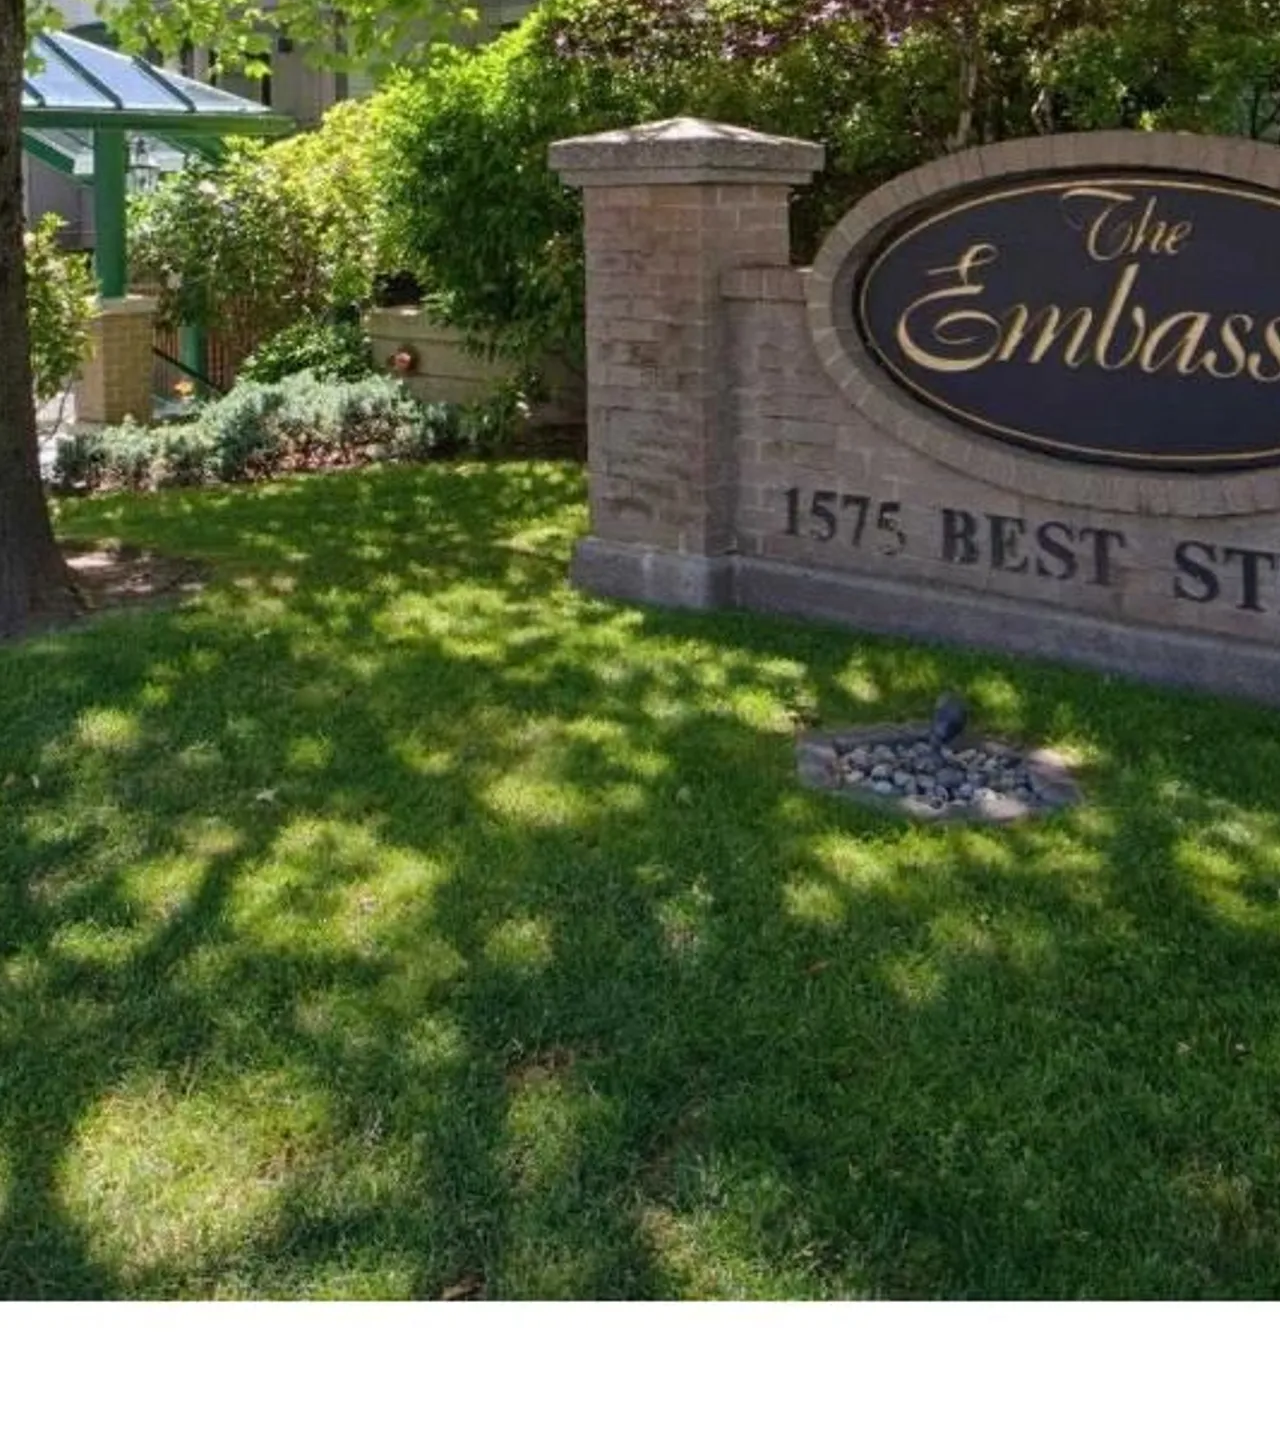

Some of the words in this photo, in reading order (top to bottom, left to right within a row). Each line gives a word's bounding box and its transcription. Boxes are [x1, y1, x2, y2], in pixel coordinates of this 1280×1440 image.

[1061, 186, 1194, 261] The
[783, 486, 907, 556] 1575
[941, 508, 1126, 586] BEST
